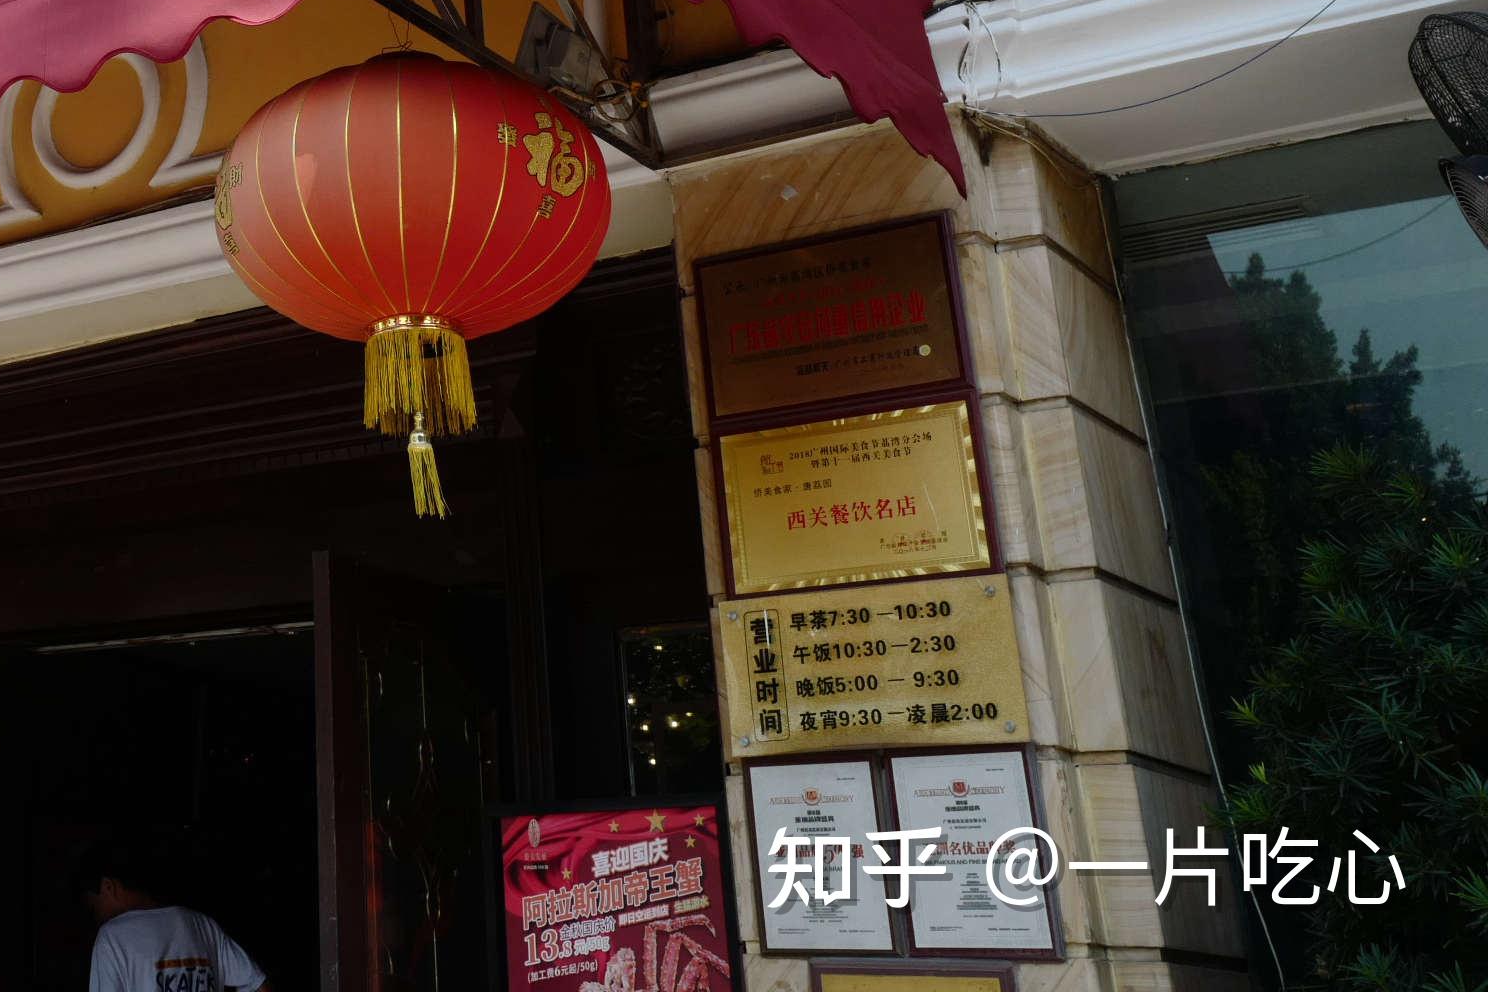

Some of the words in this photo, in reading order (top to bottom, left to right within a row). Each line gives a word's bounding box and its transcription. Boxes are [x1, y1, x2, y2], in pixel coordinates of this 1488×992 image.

[787, 495, 917, 531] 西关餐饮名店
[750, 618, 783, 735] 营业时间
[591, 838, 670, 877] 喜迎国庆
[522, 857, 704, 930] 阿拉斯加帝王蟹
